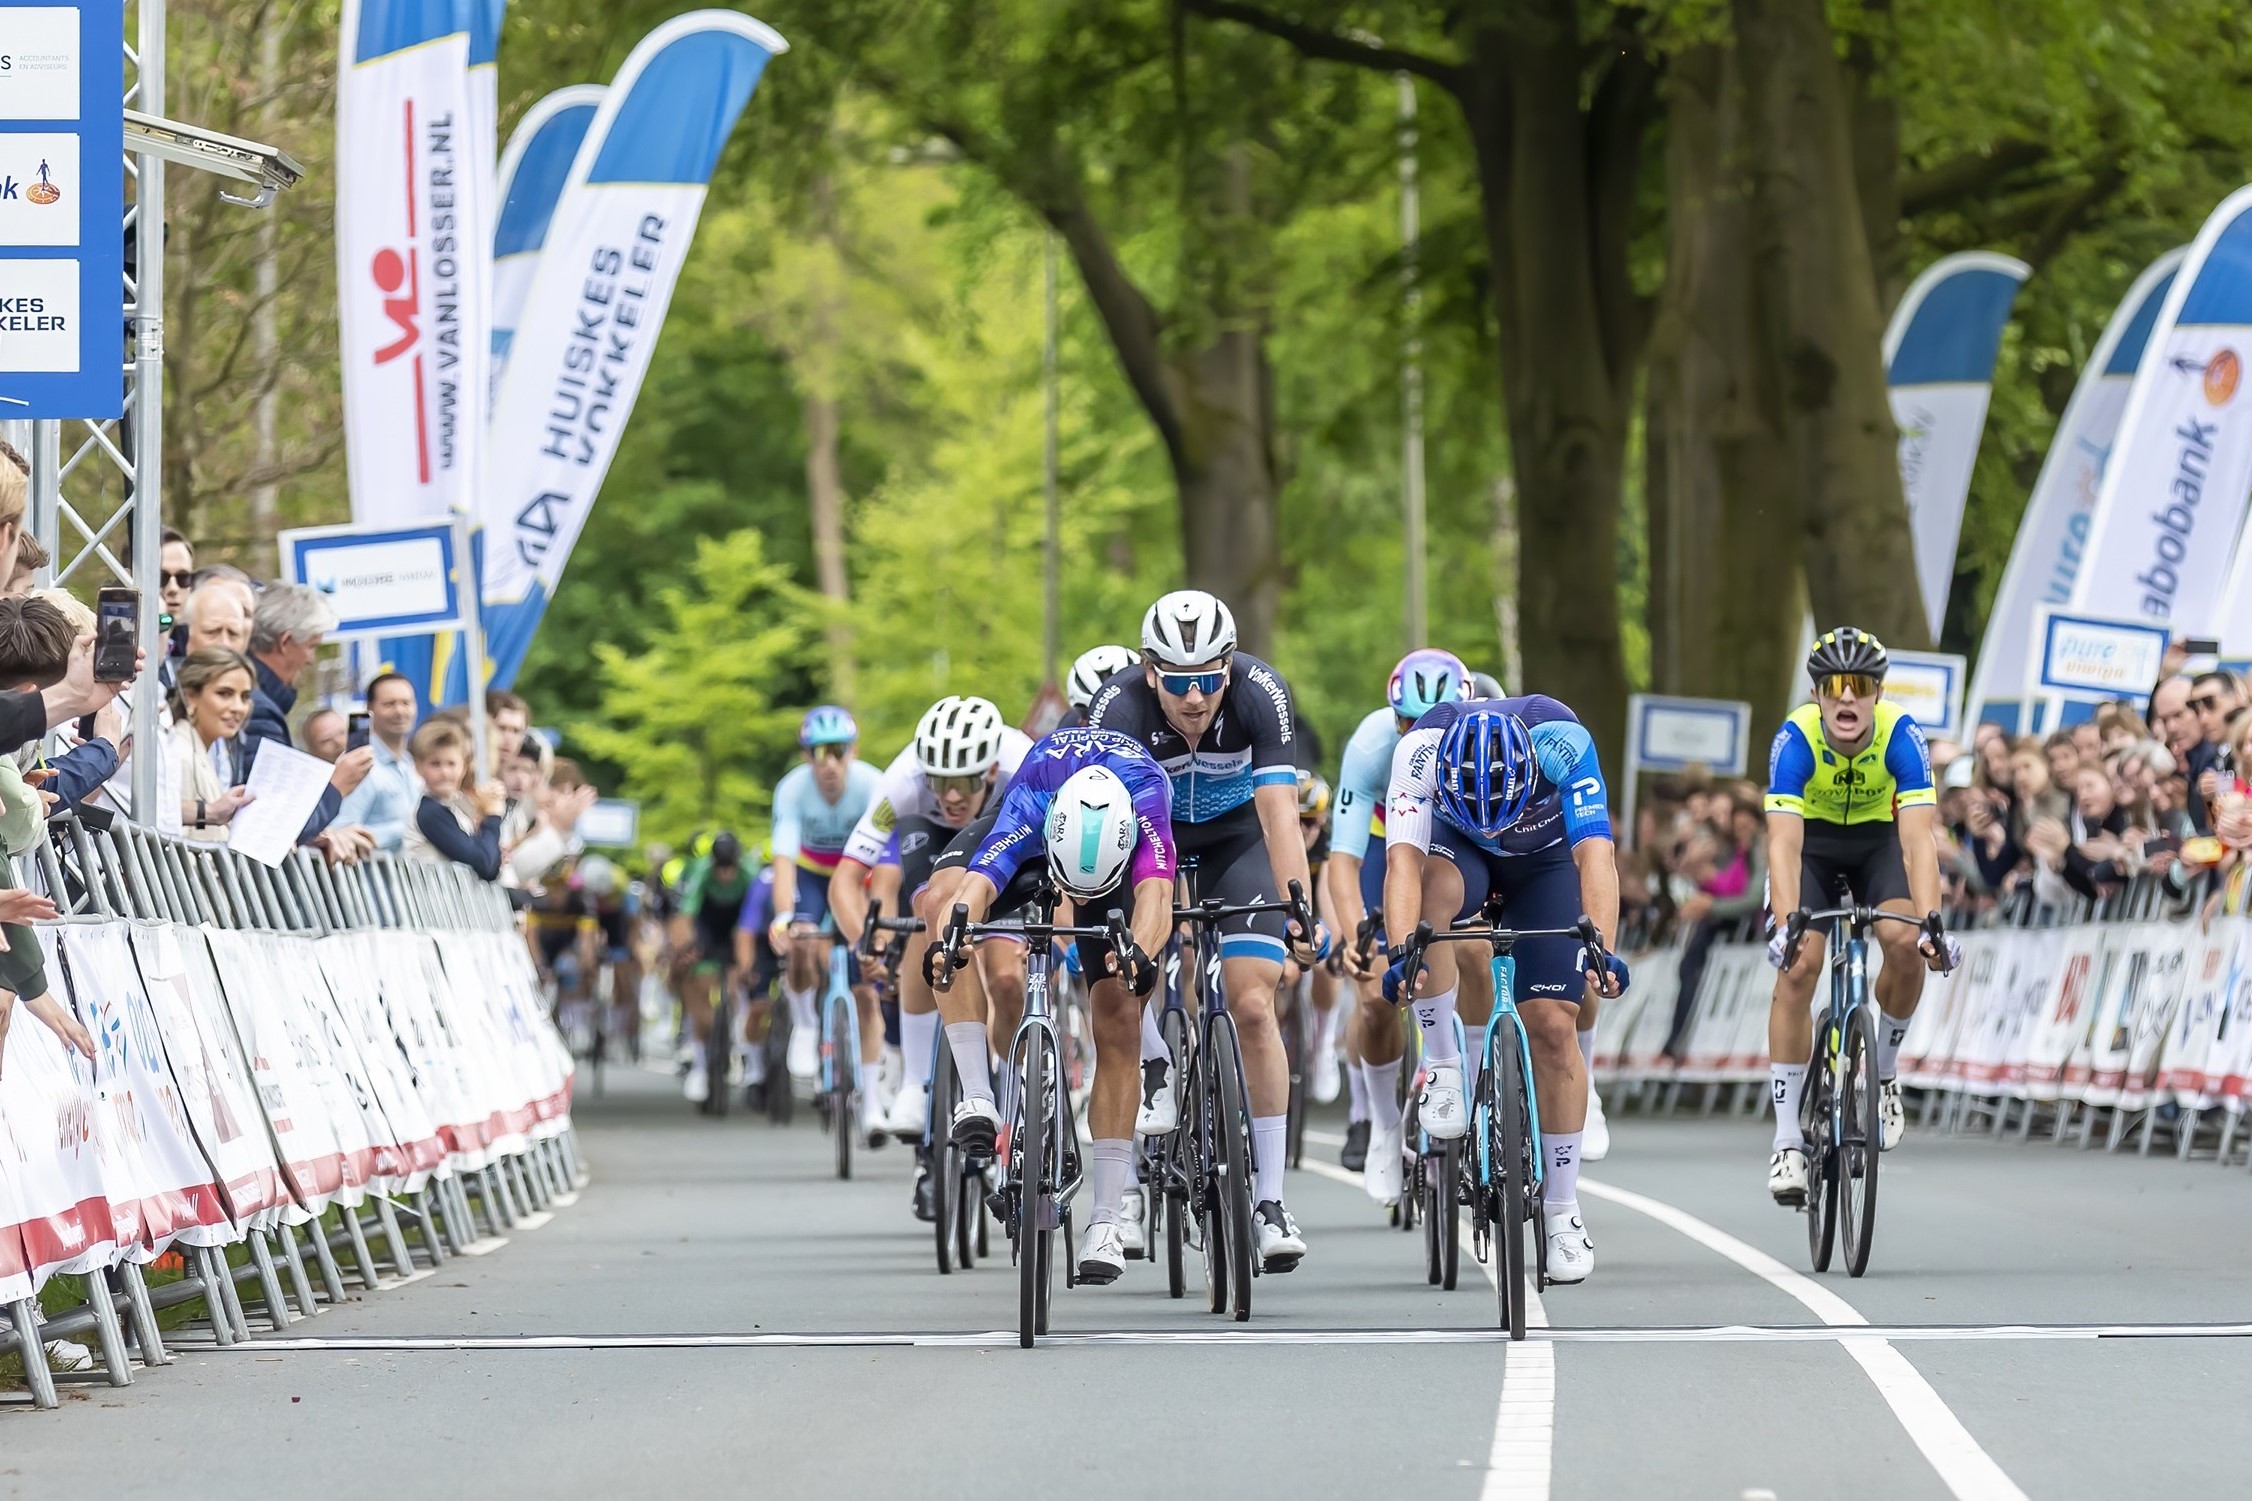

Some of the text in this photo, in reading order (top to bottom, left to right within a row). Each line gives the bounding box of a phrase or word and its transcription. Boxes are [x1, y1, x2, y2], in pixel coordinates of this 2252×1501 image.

[542, 247, 622, 458] HUISKES
[2138, 413, 2219, 618] abobank
[1248, 665, 1293, 745] VolkerWessels
[1451, 767, 1459, 791] ISRAEL
[1505, 777, 1516, 800] ISRAEL
[1499, 965, 1509, 1003] FACTOR
